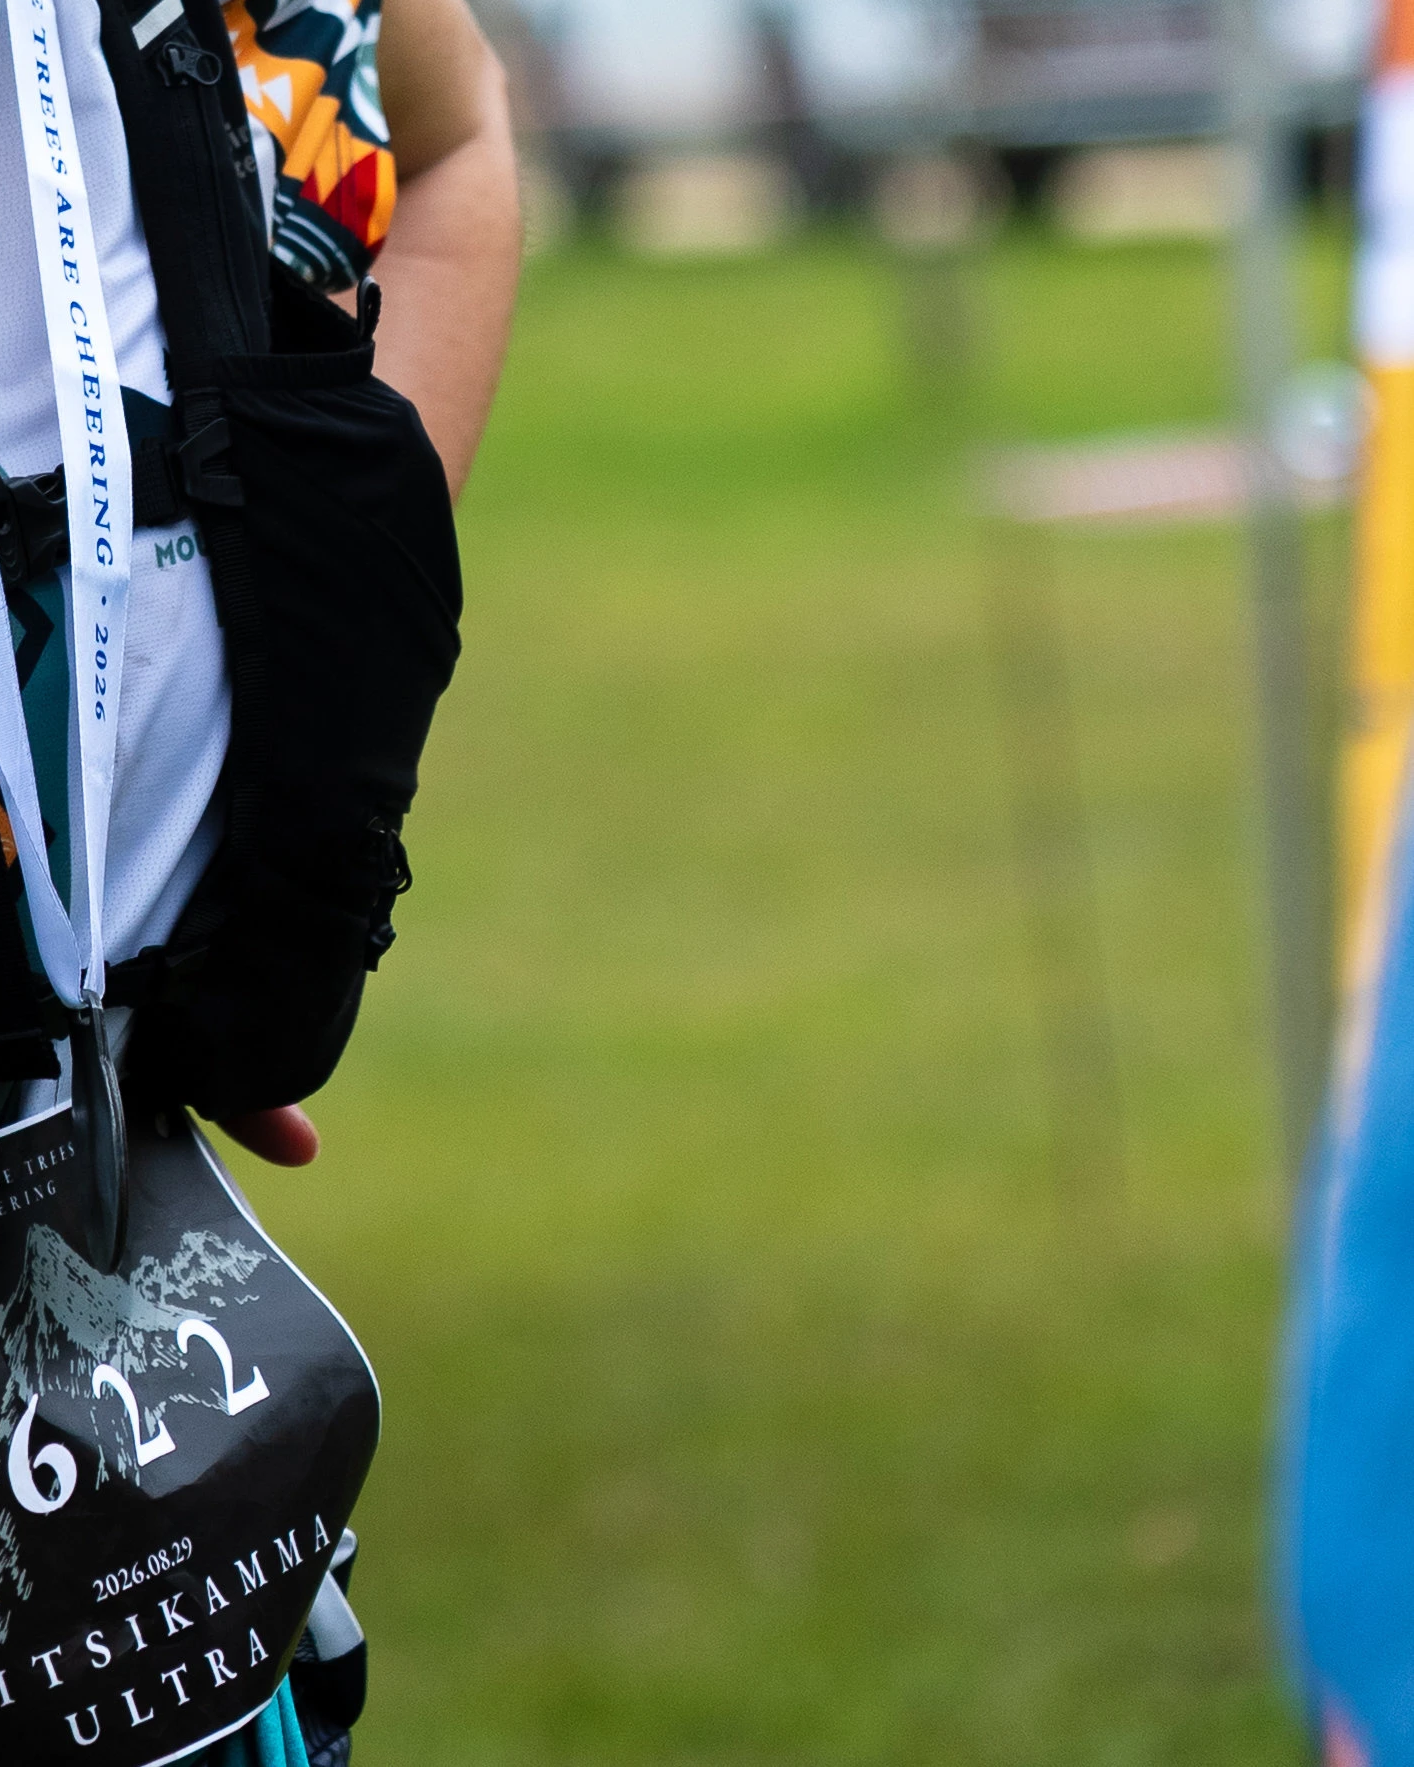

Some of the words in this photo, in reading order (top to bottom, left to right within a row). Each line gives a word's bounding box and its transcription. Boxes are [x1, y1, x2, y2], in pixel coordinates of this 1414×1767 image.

[33, 27, 68, 176] TREES
[57, 188, 80, 284] ARE
[70, 300, 115, 567] CHEERING
[95, 622, 109, 723] 2026
[24, 1140, 76, 1176] TREES
[92, 1536, 193, 1603] 2026.08.29
[65, 1626, 269, 1746] ULTRA
